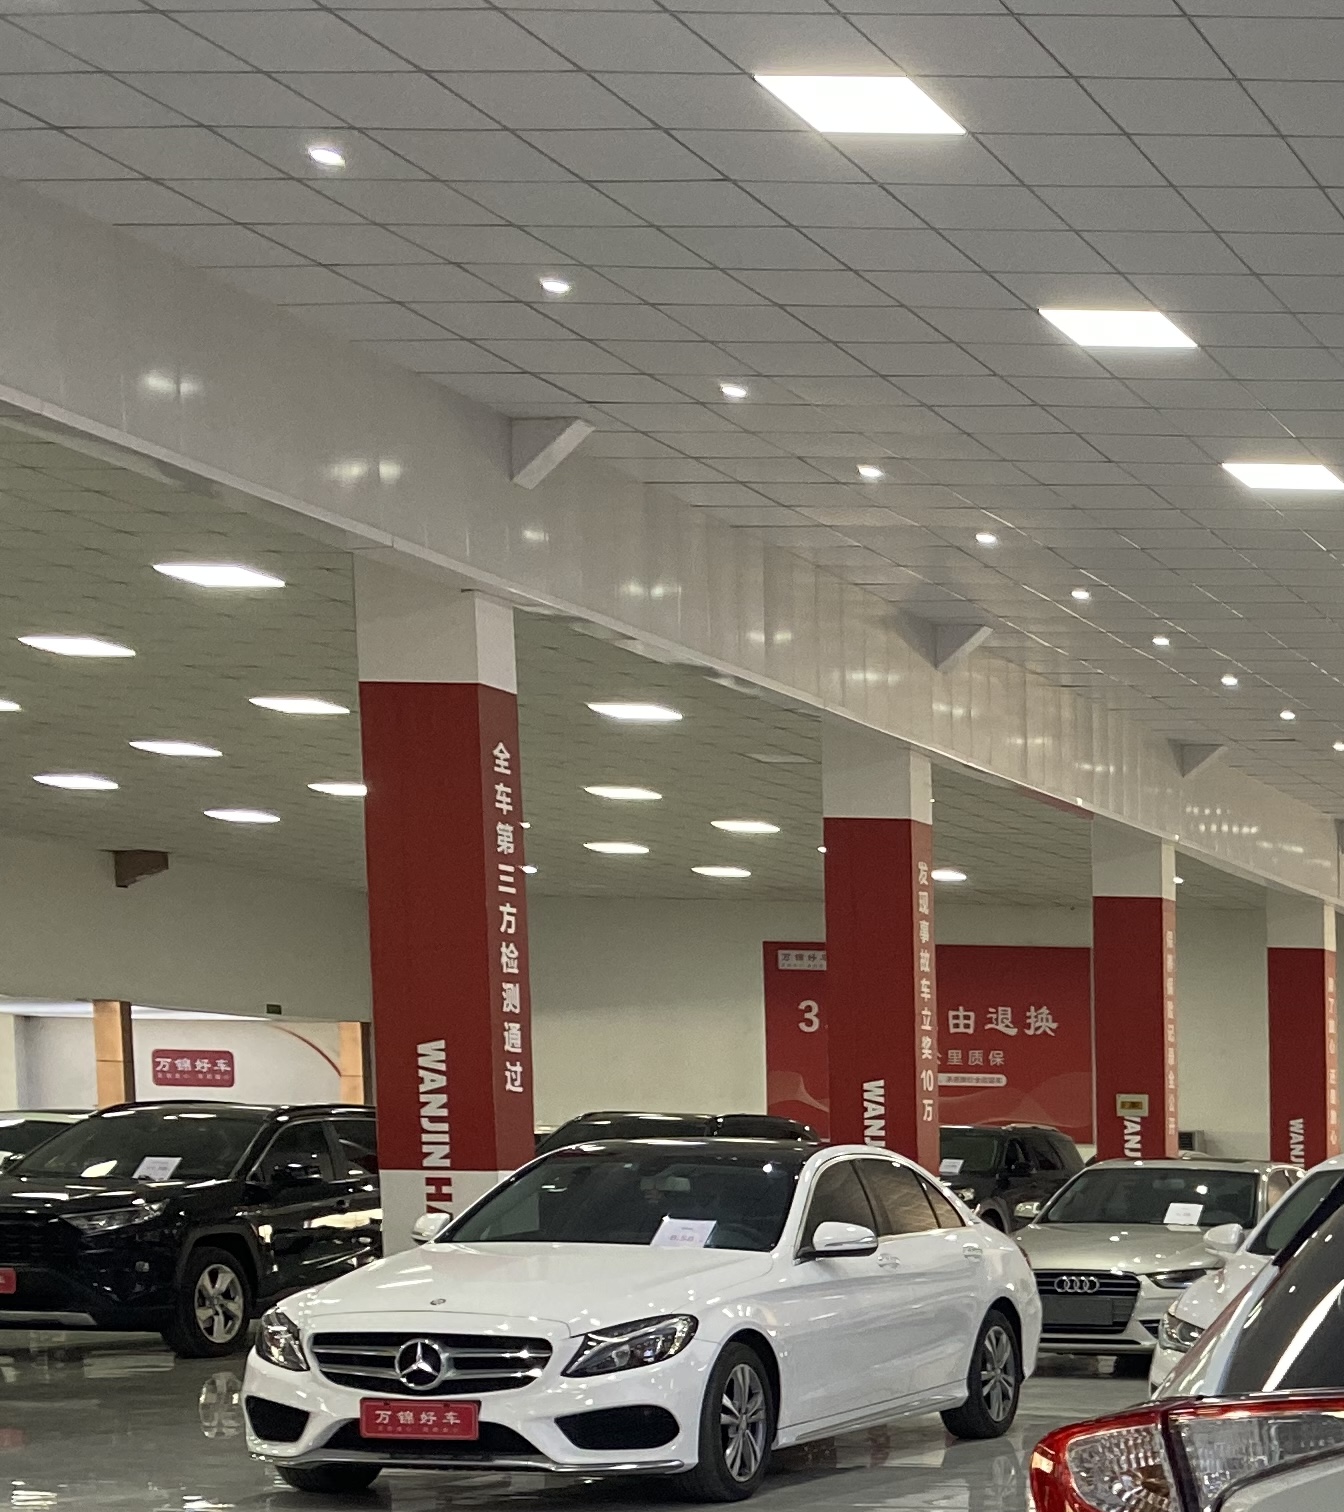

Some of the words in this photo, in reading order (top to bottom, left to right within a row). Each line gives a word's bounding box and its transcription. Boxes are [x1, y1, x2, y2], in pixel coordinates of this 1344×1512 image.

[491, 741, 525, 1093] 全车第三方检测通过
[798, 1000, 820, 1033] 3
[917, 861, 934, 1122] 发现事故车立奖10万
[417, 1039, 452, 1168] WANJIN
[375, 1410, 461, 1425] 万锦好车
